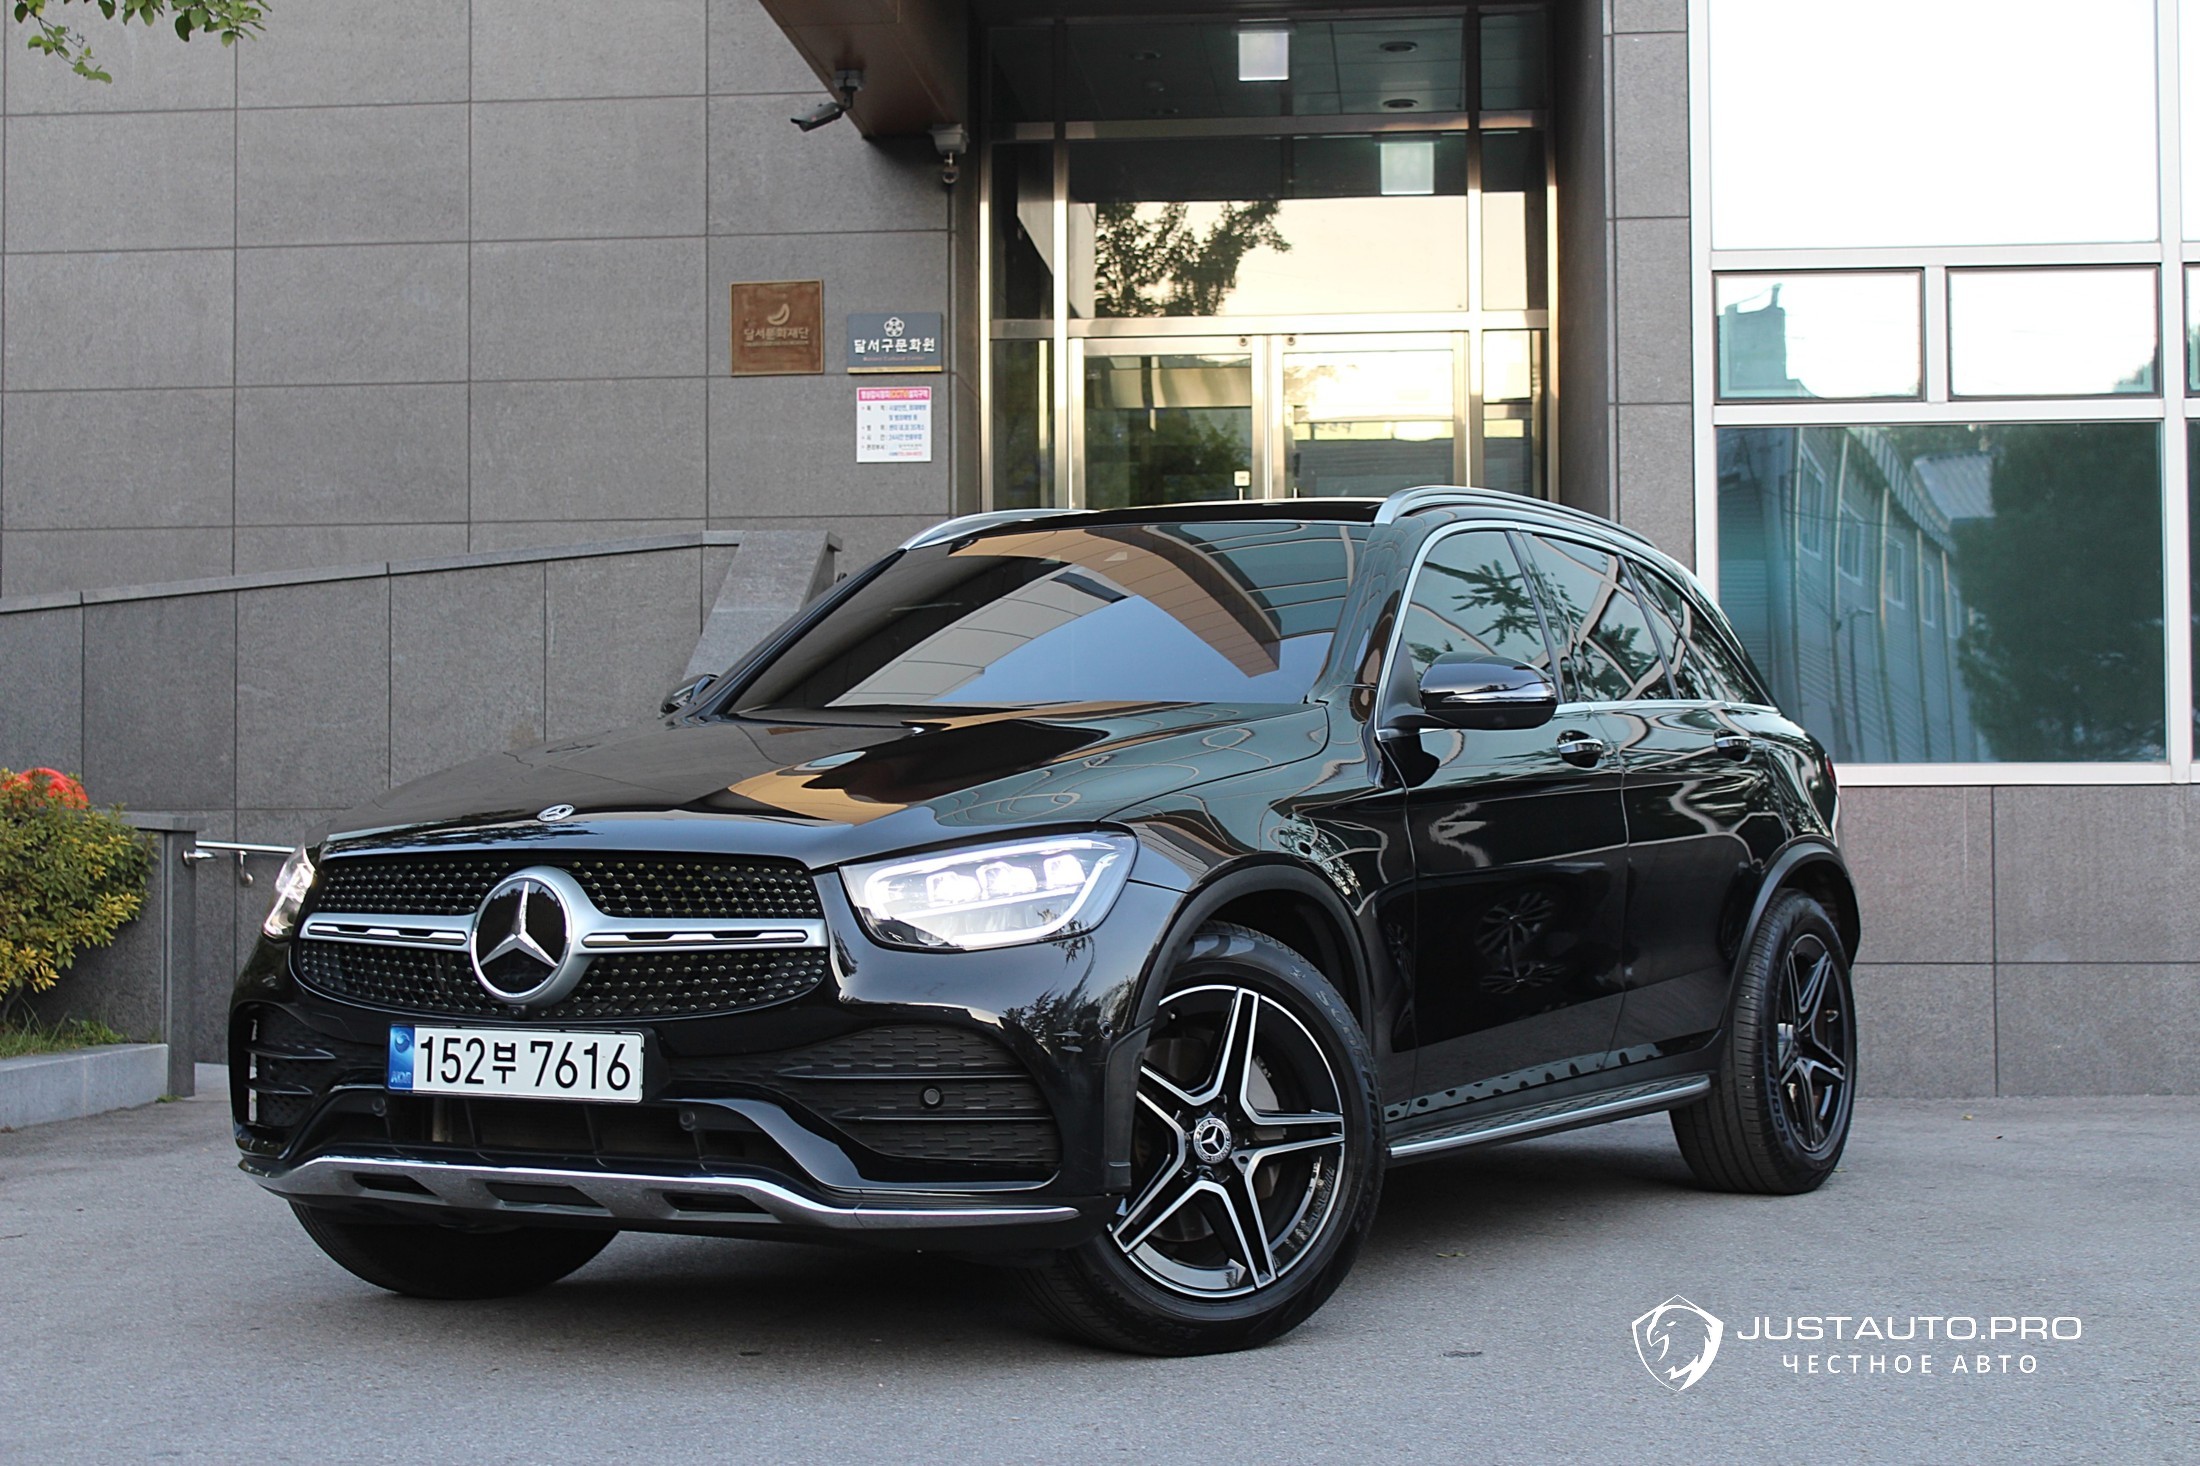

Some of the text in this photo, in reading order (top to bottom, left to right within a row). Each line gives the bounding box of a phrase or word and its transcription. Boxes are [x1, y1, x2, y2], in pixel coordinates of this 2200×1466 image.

[853, 337, 935, 354] 달서구문화원
[420, 1036, 631, 1091] 152부 7616
